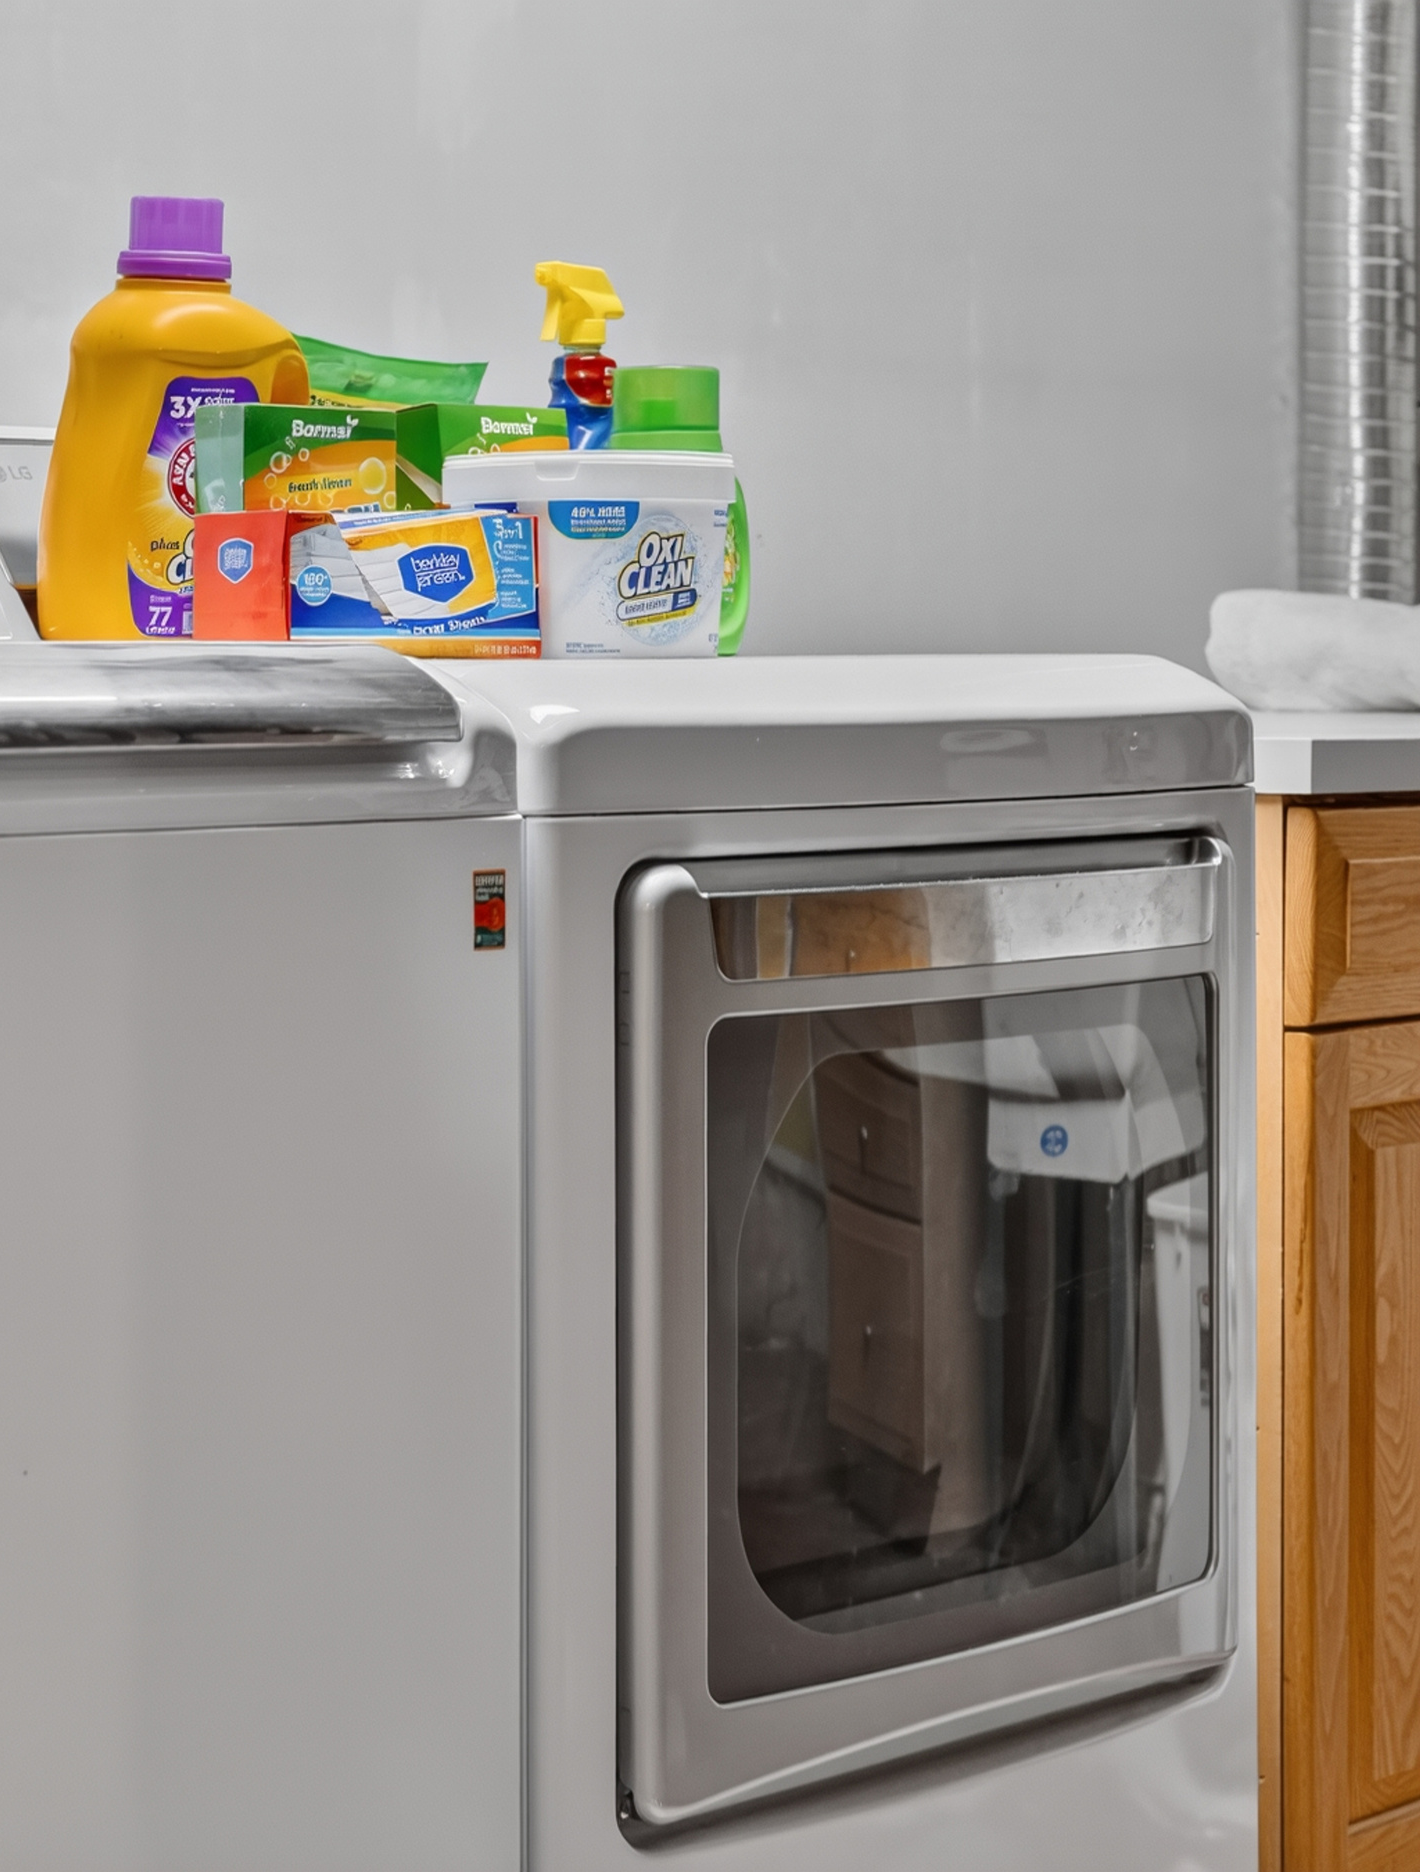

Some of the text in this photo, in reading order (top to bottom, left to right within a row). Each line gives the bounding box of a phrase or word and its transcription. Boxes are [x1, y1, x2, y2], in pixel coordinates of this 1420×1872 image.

[170, 396, 202, 419] 3X
[7, 465, 33, 480] LG
[639, 532, 685, 566] OXI
[618, 557, 695, 599] CLEAN
[149, 606, 172, 627] 77
